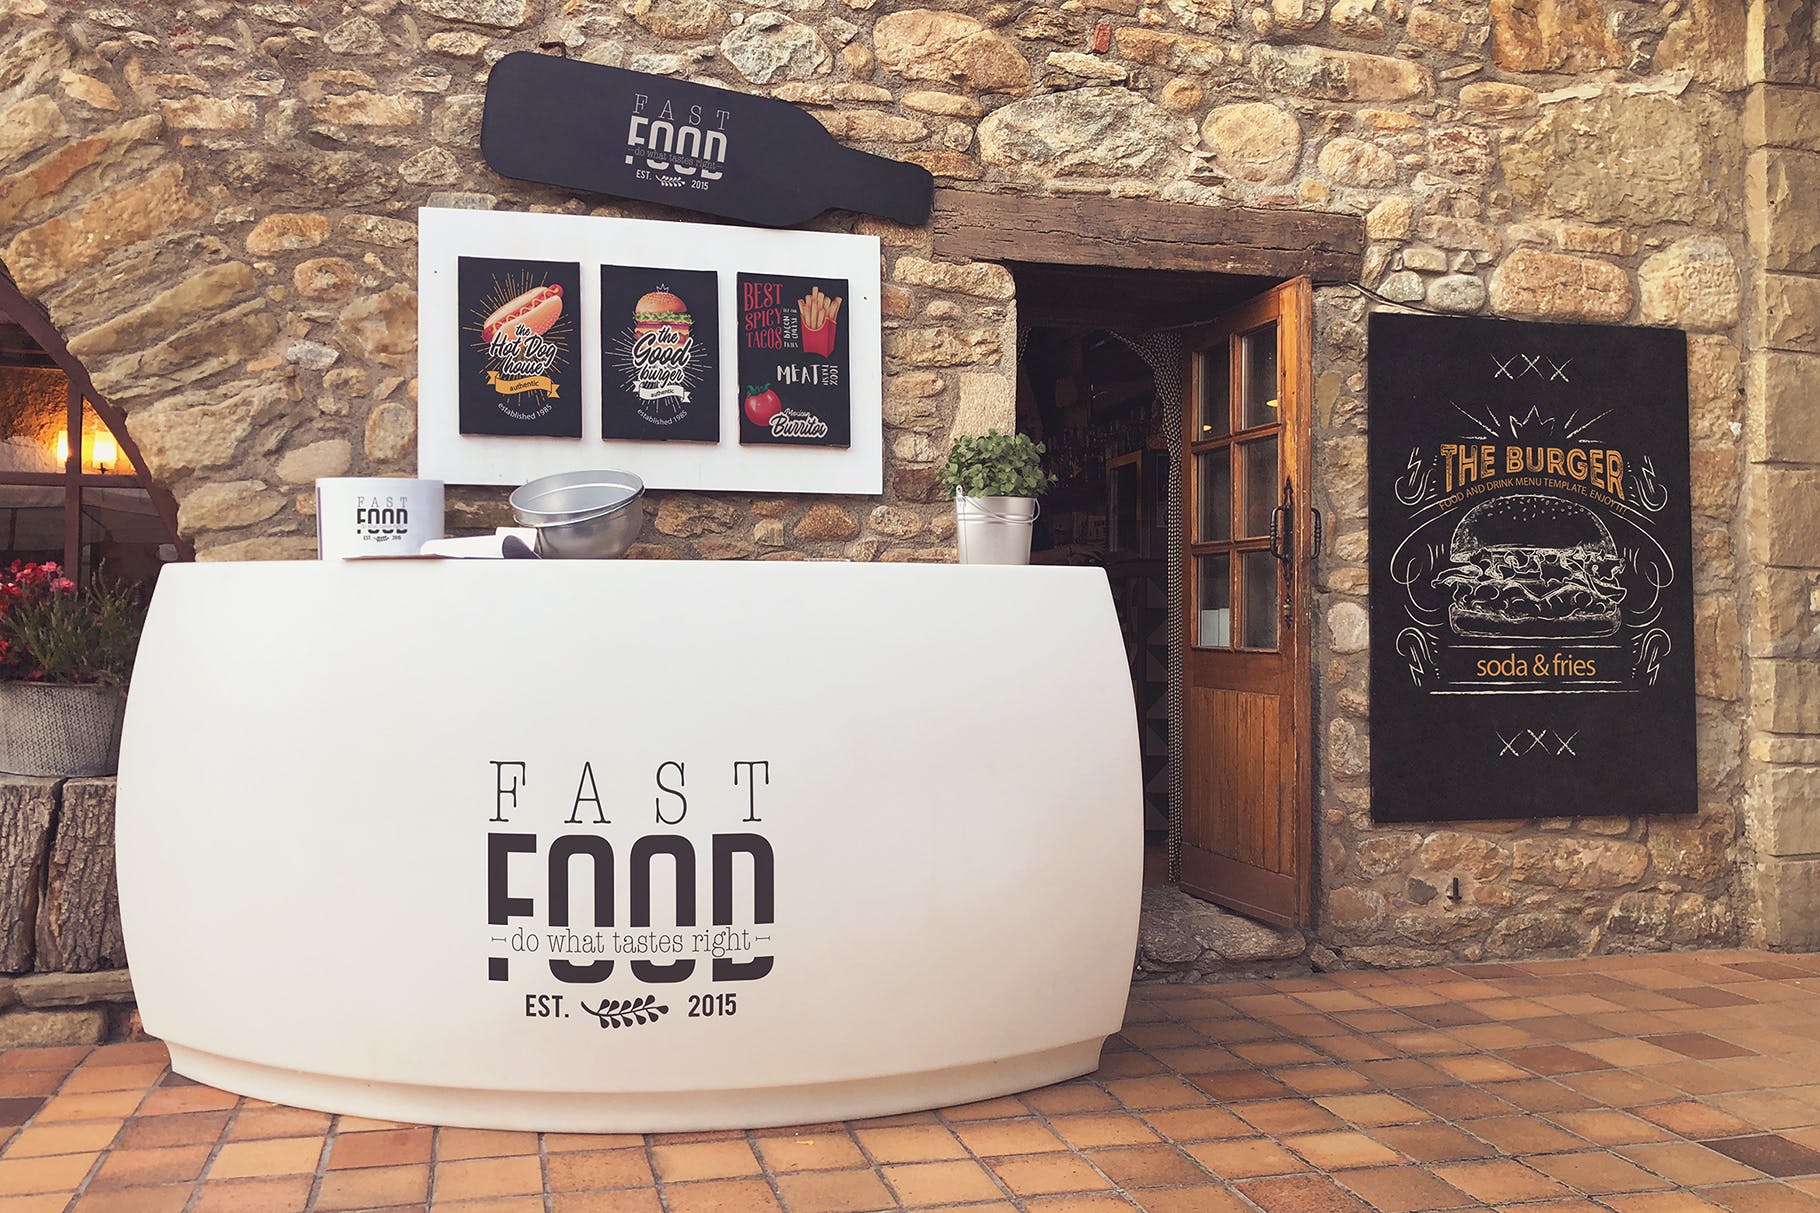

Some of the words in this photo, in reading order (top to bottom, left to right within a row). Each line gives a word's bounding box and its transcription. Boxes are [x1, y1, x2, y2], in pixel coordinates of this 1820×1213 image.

[633, 93, 730, 131] FAST
[625, 115, 728, 180] FOOD
[635, 169, 653, 181] EST.
[691, 179, 709, 191] 2015
[743, 282, 784, 312] BEST
[515, 323, 531, 337] the
[744, 306, 783, 331] SPICY
[657, 325, 680, 345] the
[746, 326, 783, 351] TACOS
[488, 329, 521, 357] Hot
[524, 333, 558, 368] Dog
[632, 331, 694, 369] Good
[502, 355, 545, 376] house
[638, 363, 685, 389] burger
[776, 363, 821, 386] MEAT
[829, 365, 839, 386] 100%
[510, 380, 540, 392] authentic
[650, 388, 675, 398] authentic
[497, 402, 536, 420] established
[536, 403, 553, 417] 1985
[637, 408, 673, 426] established
[769, 411, 829, 438] Burritos
[1440, 443, 1496, 493] THE
[1506, 446, 1625, 501] BURGER
[357, 496, 408, 507] FAST
[1438, 491, 1465, 511] FOOD
[1466, 484, 1486, 498] AND
[1486, 478, 1514, 491] DRINK
[1515, 477, 1542, 487] MENU
[1543, 478, 1588, 497] TEMPLATE,
[1589, 489, 1617, 508] ENJOY
[356, 508, 408, 534] FOOD
[1476, 652, 1528, 677] soda
[1533, 653, 1549, 677] &
[1552, 652, 1597, 677] fries
[488, 760, 770, 825] FAST
[487, 832, 775, 984] FOOD
[511, 927, 540, 953] do
[547, 928, 605, 953] what
[612, 931, 684, 954] tastes
[691, 926, 751, 958] right
[525, 994, 570, 1018] EST.
[688, 993, 737, 1018] 2015
